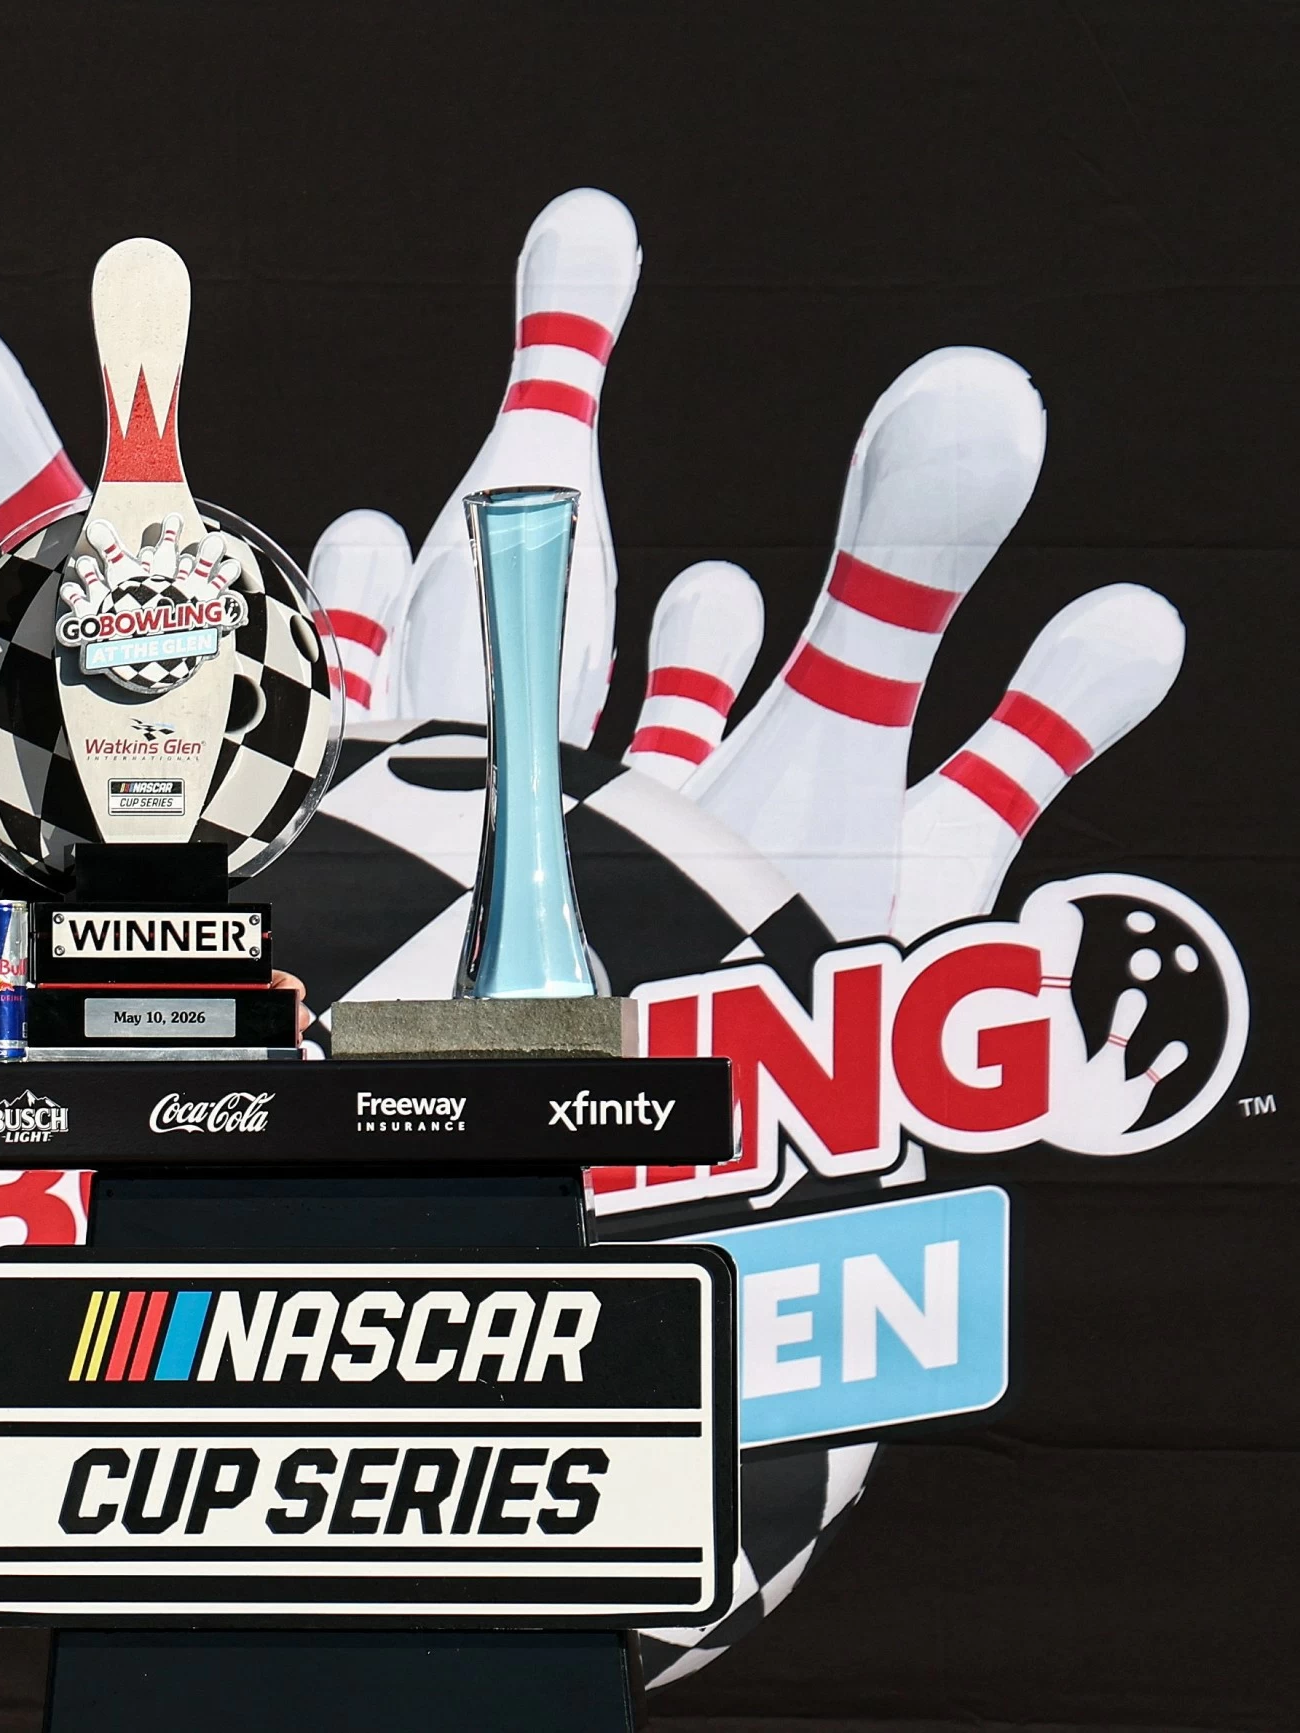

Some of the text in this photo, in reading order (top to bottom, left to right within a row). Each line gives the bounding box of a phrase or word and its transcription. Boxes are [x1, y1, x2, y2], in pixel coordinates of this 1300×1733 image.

[92, 632, 213, 663] AT THE GLEN
[85, 739, 202, 754] Watkins Glen
[132, 783, 173, 792] NASCAR
[120, 798, 173, 807] CUP SERIES
[68, 919, 246, 952] WINNER
[0, 960, 28, 976] Bull
[114, 1011, 206, 1025] May 10, 2026
[149, 1092, 276, 1133] Coca-Cola
[357, 1092, 467, 1120] Freeway
[548, 1089, 676, 1131] xfinity
[5, 1131, 50, 1142] LIGHT
[357, 1121, 466, 1131] INSURANCE
[198, 1291, 602, 1382] NASCAR
[57, 1447, 611, 1536] CUP SERIES
